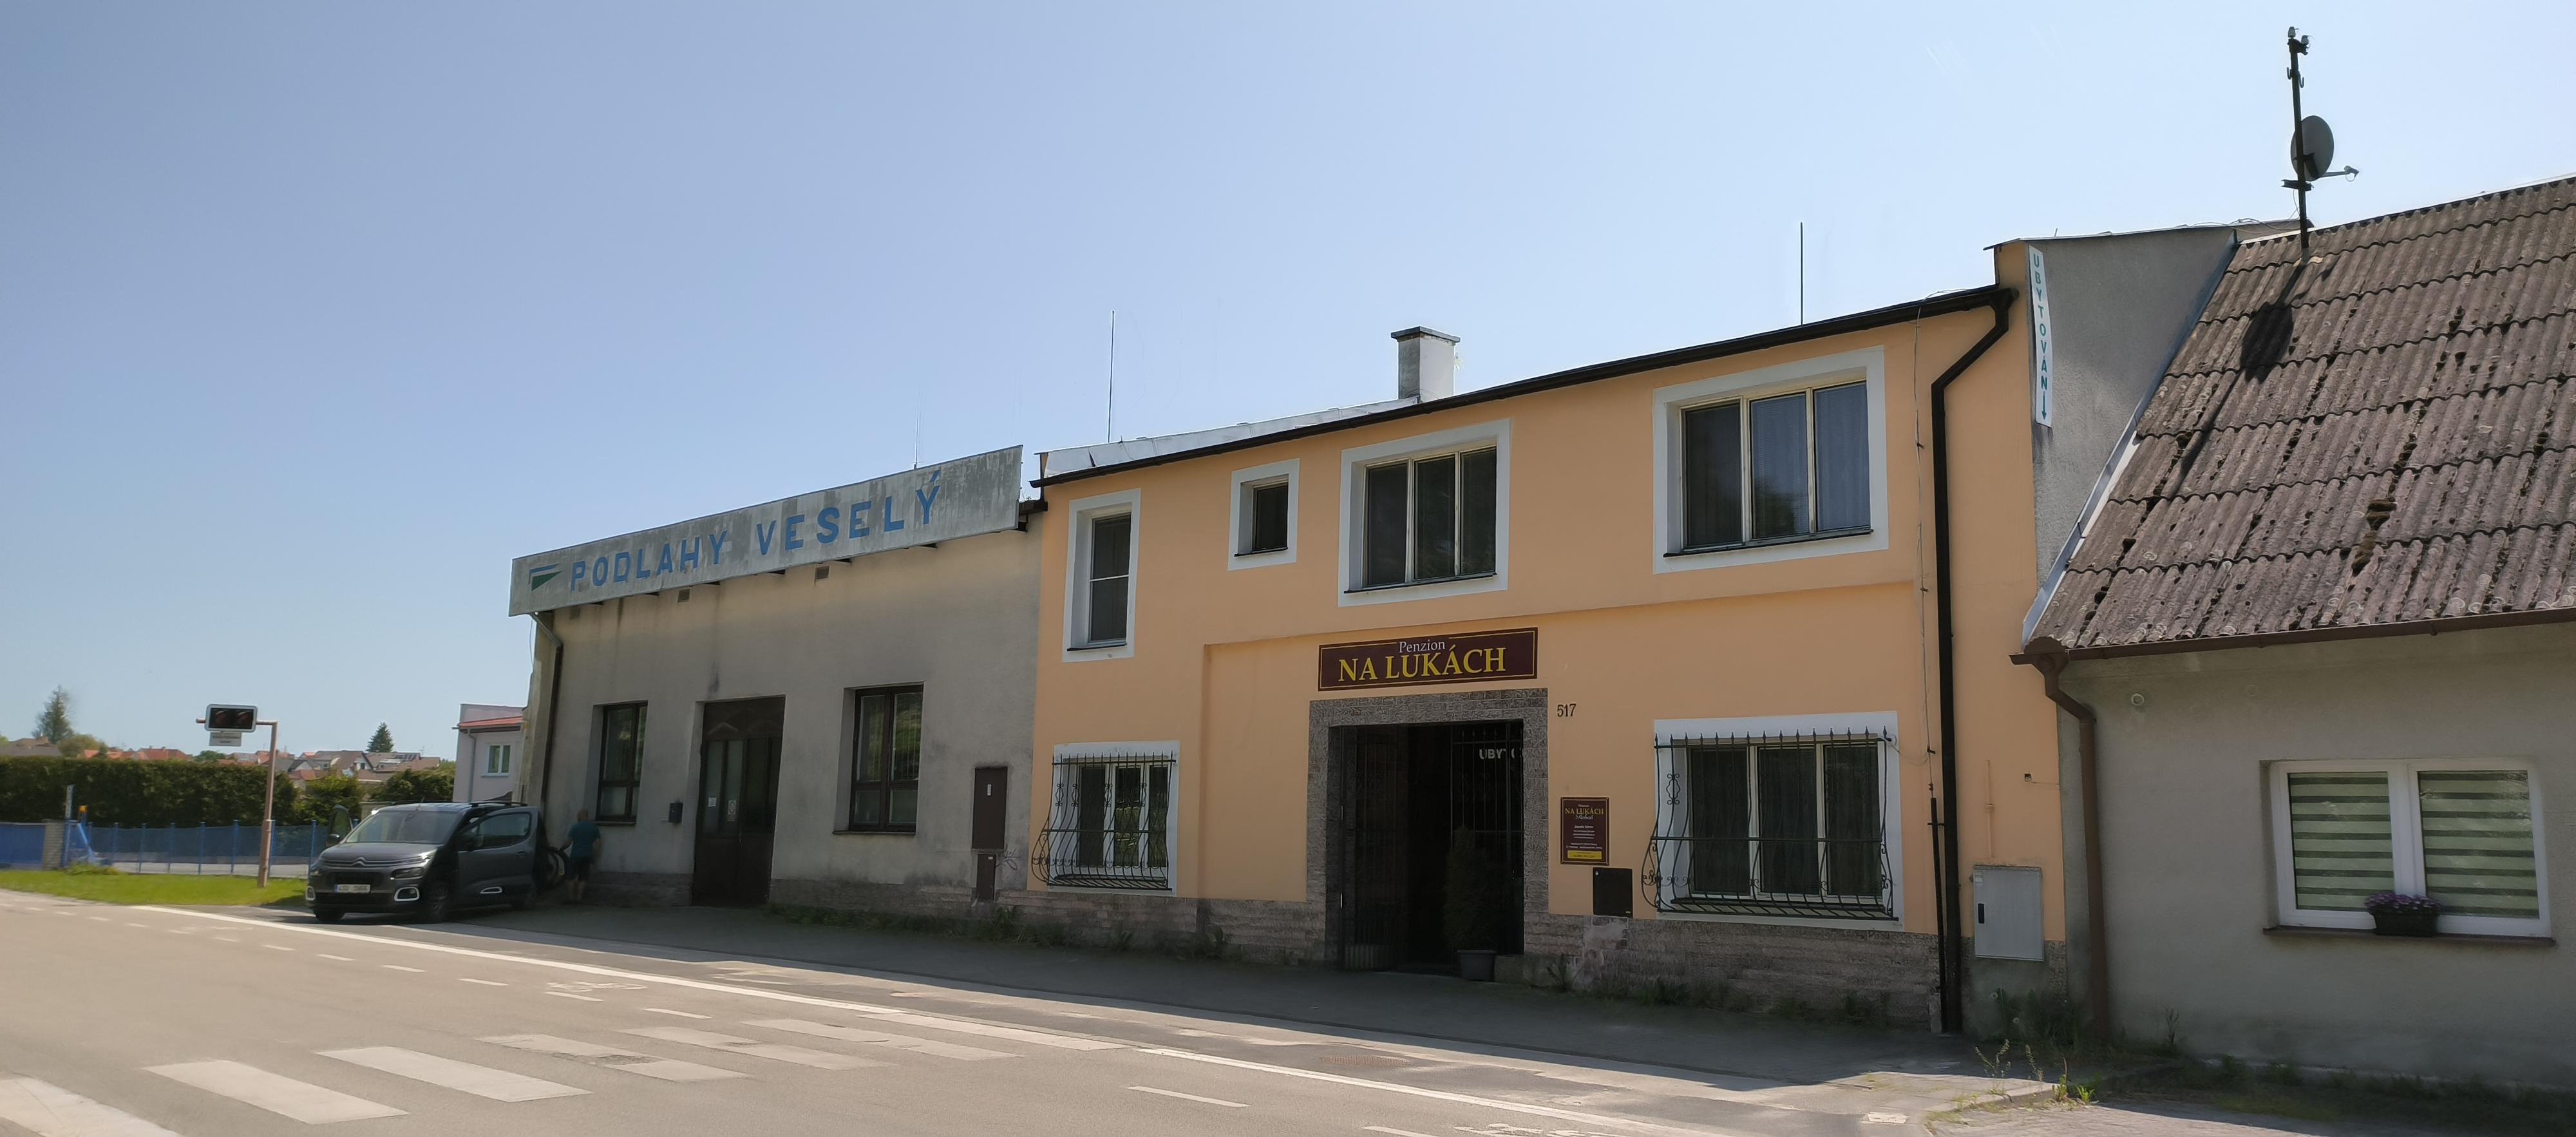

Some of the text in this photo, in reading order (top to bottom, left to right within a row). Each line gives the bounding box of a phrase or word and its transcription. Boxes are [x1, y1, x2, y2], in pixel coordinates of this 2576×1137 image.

[571, 470, 941, 592] PODLAHY VESELÝ
[1399, 639, 1446, 653] Penzion
[1338, 644, 1506, 682] NA LUKÁCH
[1557, 703, 1577, 717] 517
